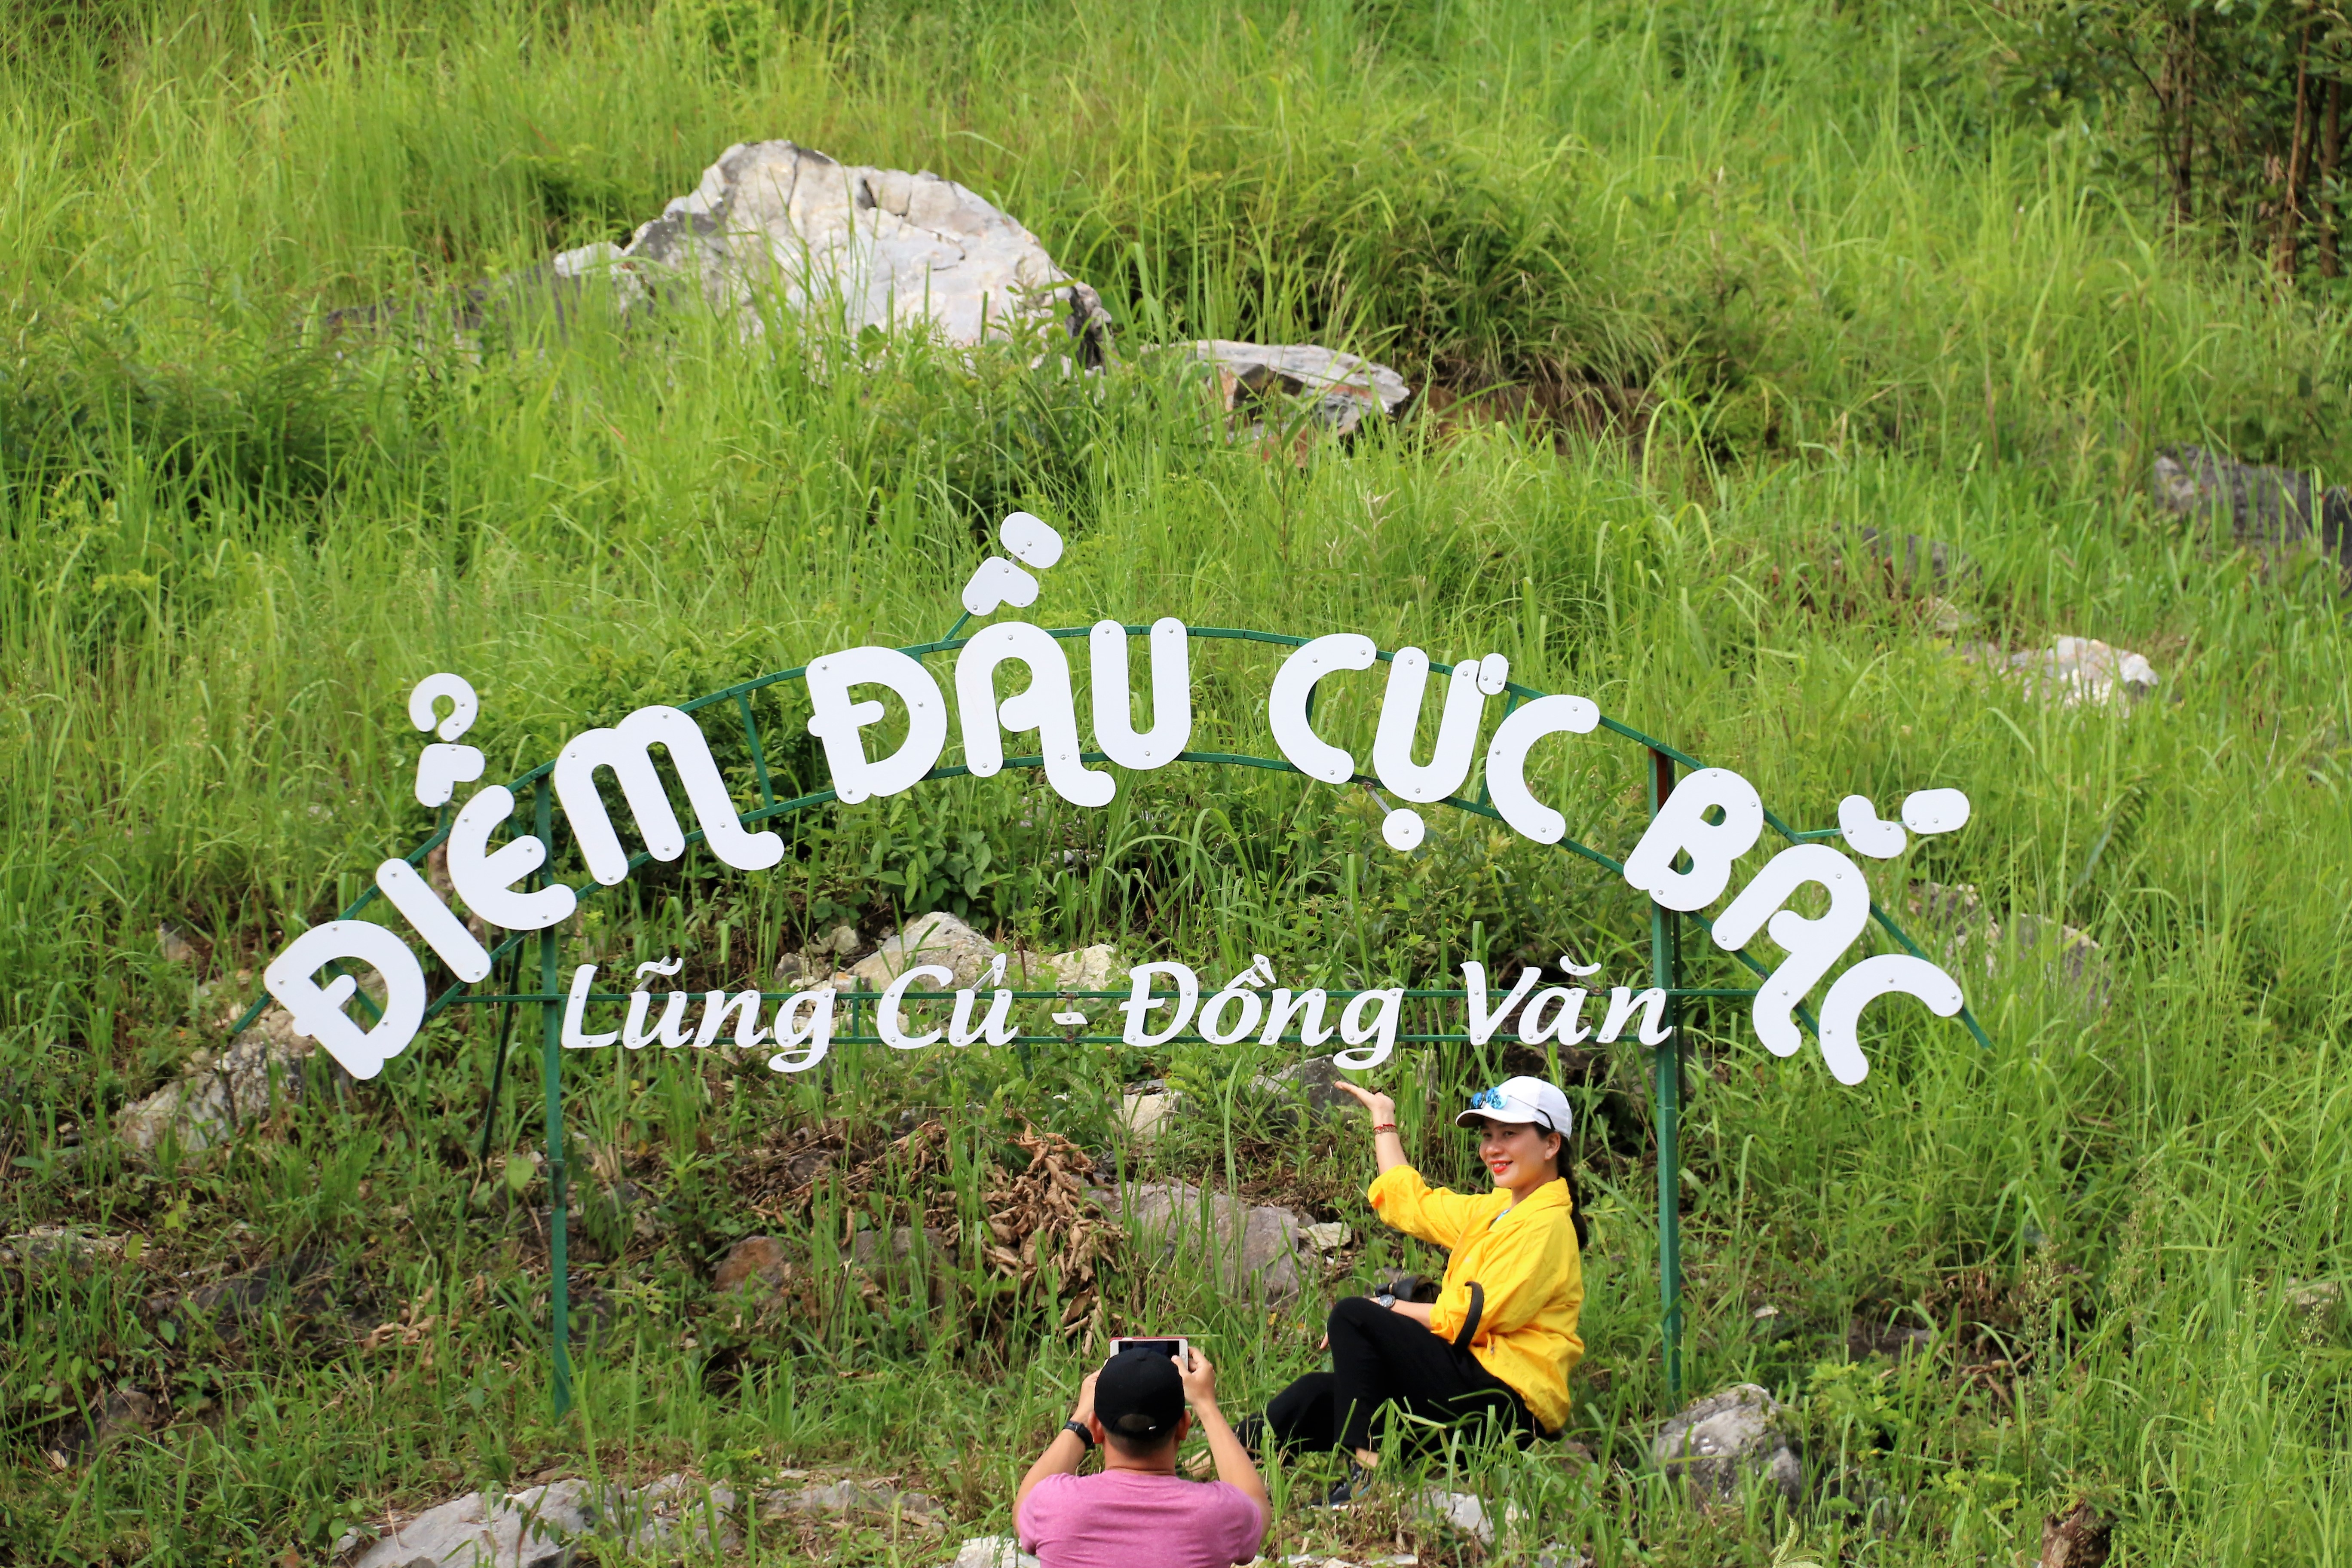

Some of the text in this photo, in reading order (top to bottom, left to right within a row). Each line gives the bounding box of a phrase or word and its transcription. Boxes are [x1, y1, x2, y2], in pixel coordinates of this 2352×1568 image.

[806, 512, 1191, 807] ĐẦU
[1269, 633, 1600, 851] CỰC
[1623, 788, 1970, 1085] BẮC
[561, 953, 1672, 1072] Lũng Cú - Đồng Văn
